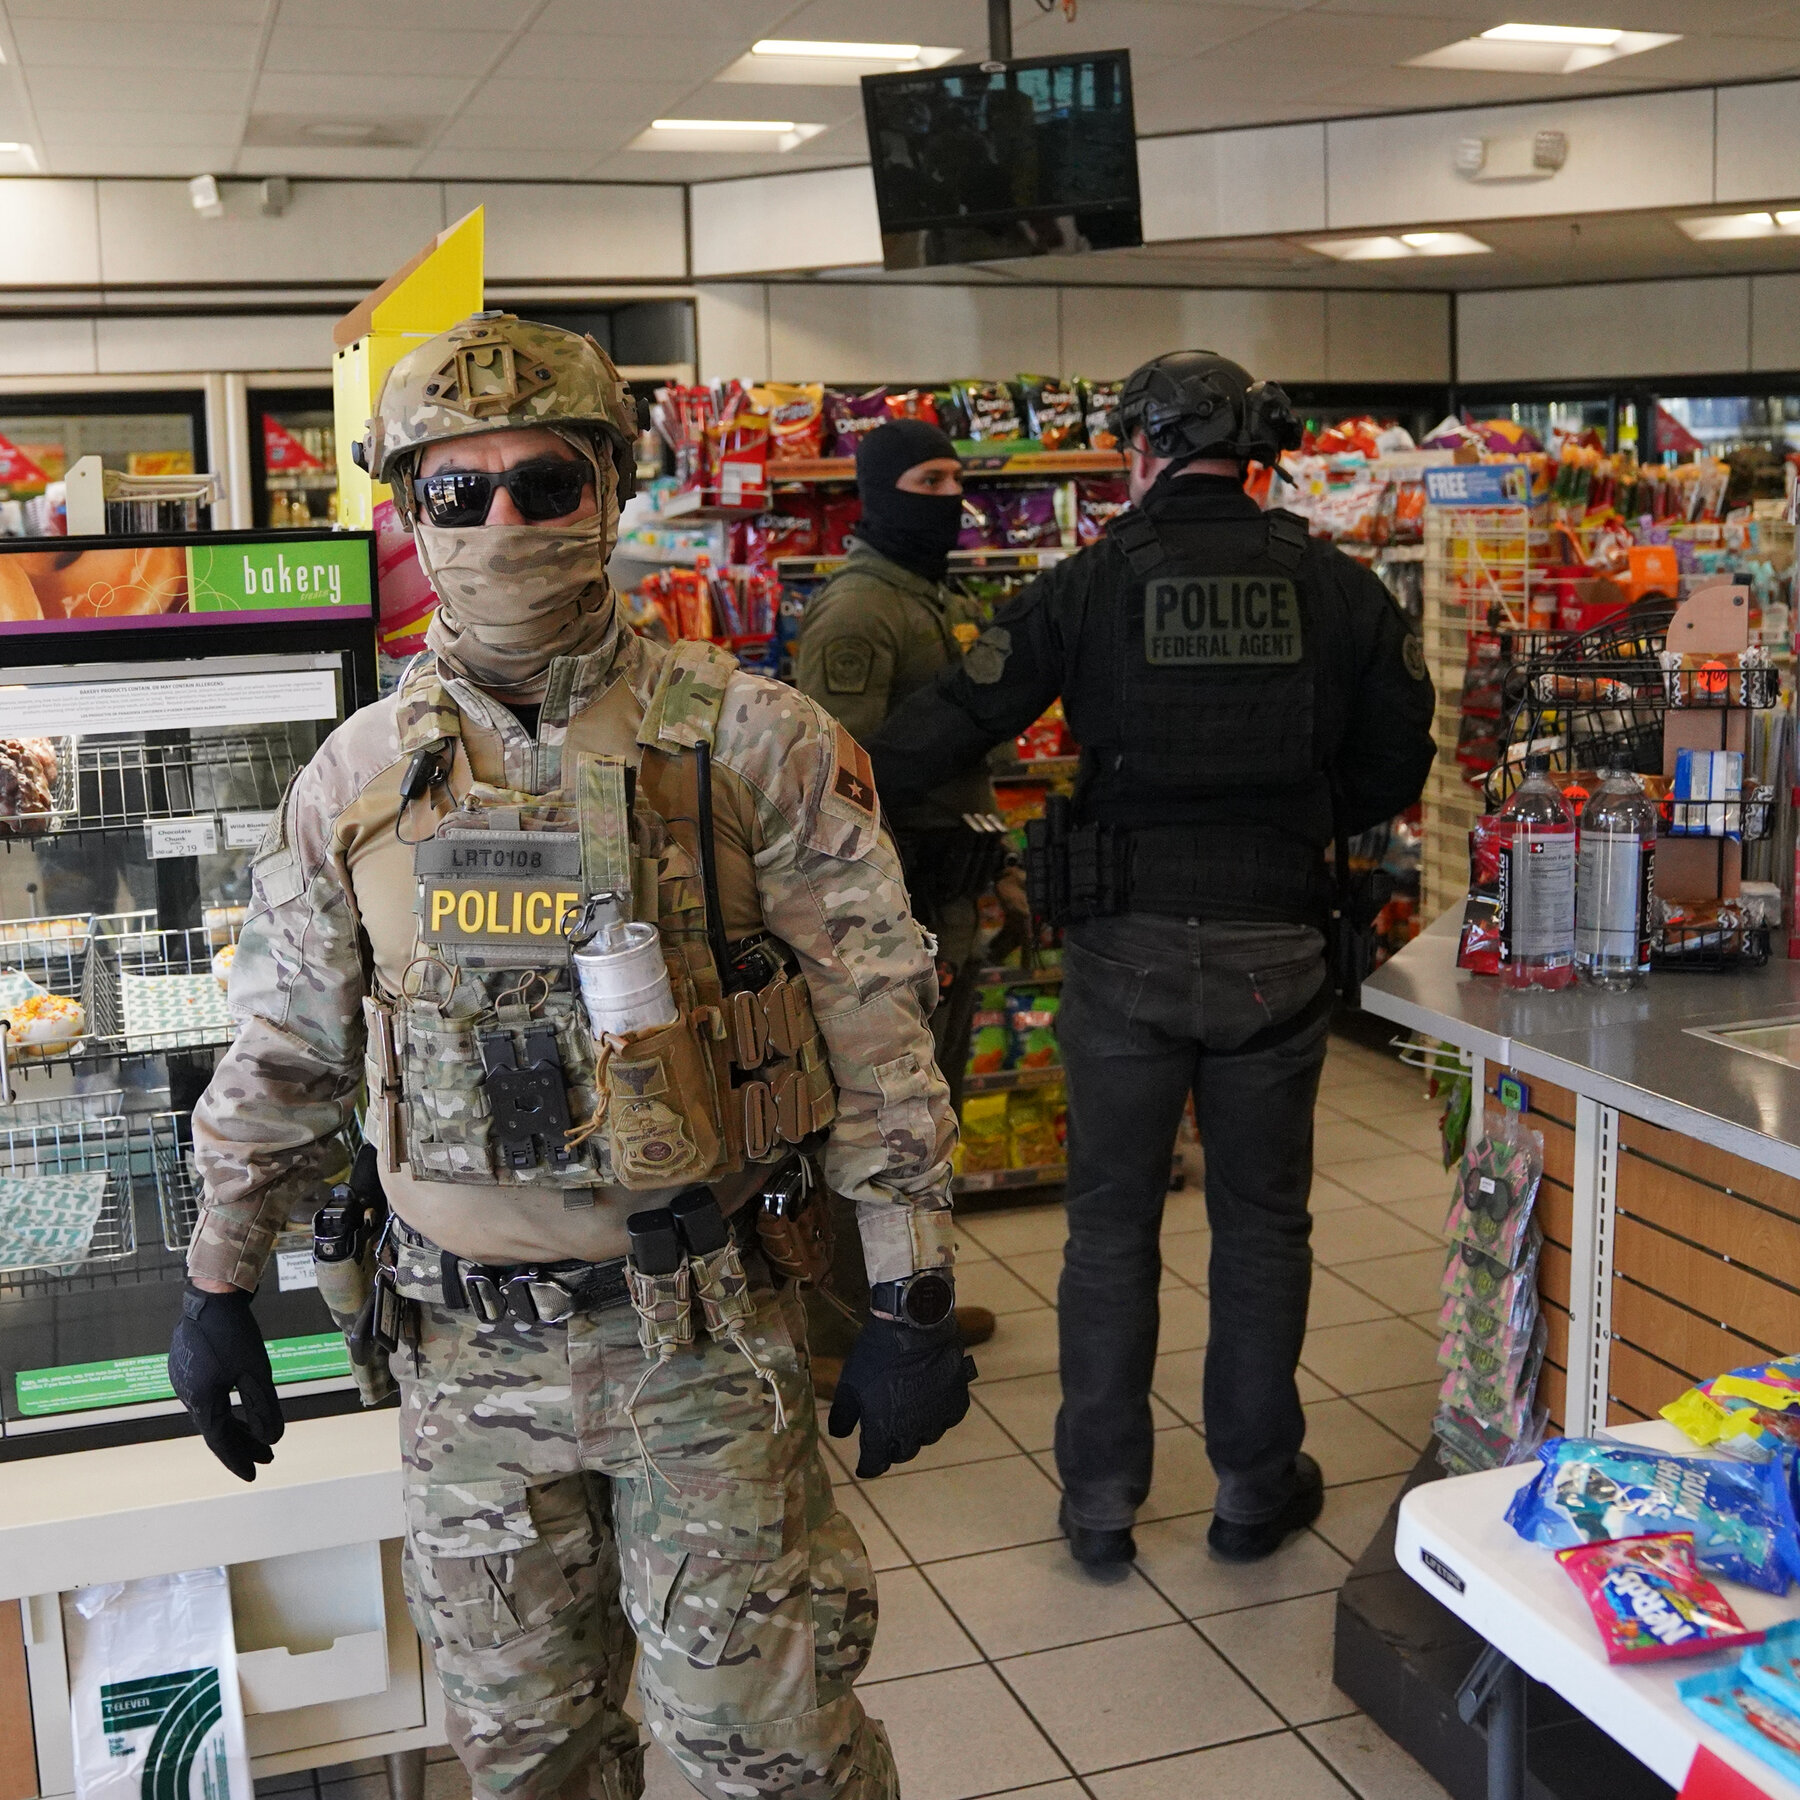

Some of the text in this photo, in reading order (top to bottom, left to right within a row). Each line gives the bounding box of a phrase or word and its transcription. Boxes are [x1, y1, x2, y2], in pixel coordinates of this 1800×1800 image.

[1427, 472, 1468, 499] FREE
[243, 553, 341, 604] bakery
[1155, 581, 1290, 631] POLICE
[1153, 632, 1294, 658] FEDERAL AGENT
[431, 889, 579, 936] POLICE
